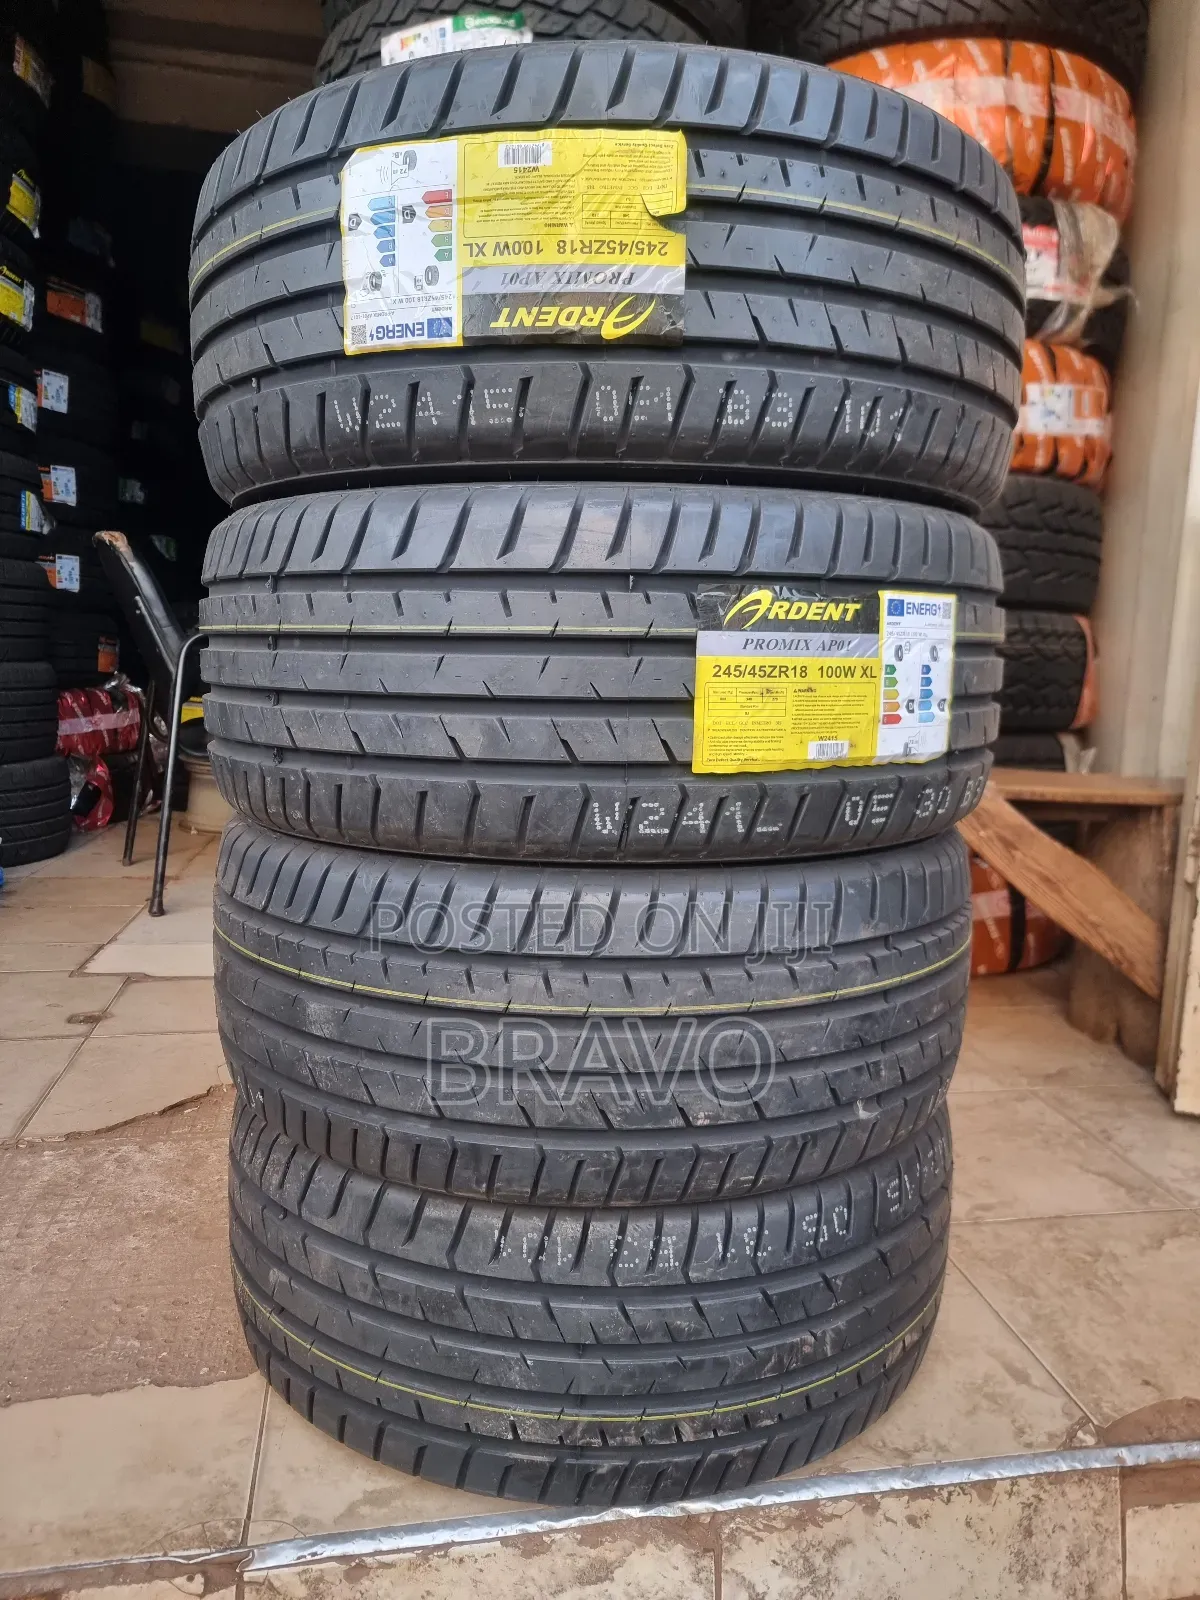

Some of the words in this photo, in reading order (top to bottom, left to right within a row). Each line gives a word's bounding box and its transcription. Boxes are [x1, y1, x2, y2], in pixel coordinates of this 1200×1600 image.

[462, 242, 487, 258] XL
[492, 240, 544, 257] 100W
[556, 239, 669, 257] 245/45ZR18
[500, 271, 546, 287] AP01
[551, 271, 636, 286] PROMIX
[489, 295, 656, 340] ARDENT
[375, 321, 425, 341] ENERG
[723, 589, 862, 630] ARDENT
[906, 601, 938, 616] ENERG
[742, 638, 813, 651] PROMIX
[712, 664, 808, 679] 245/45ZR18
[817, 665, 857, 679] 100W
[860, 665, 878, 679] XL
